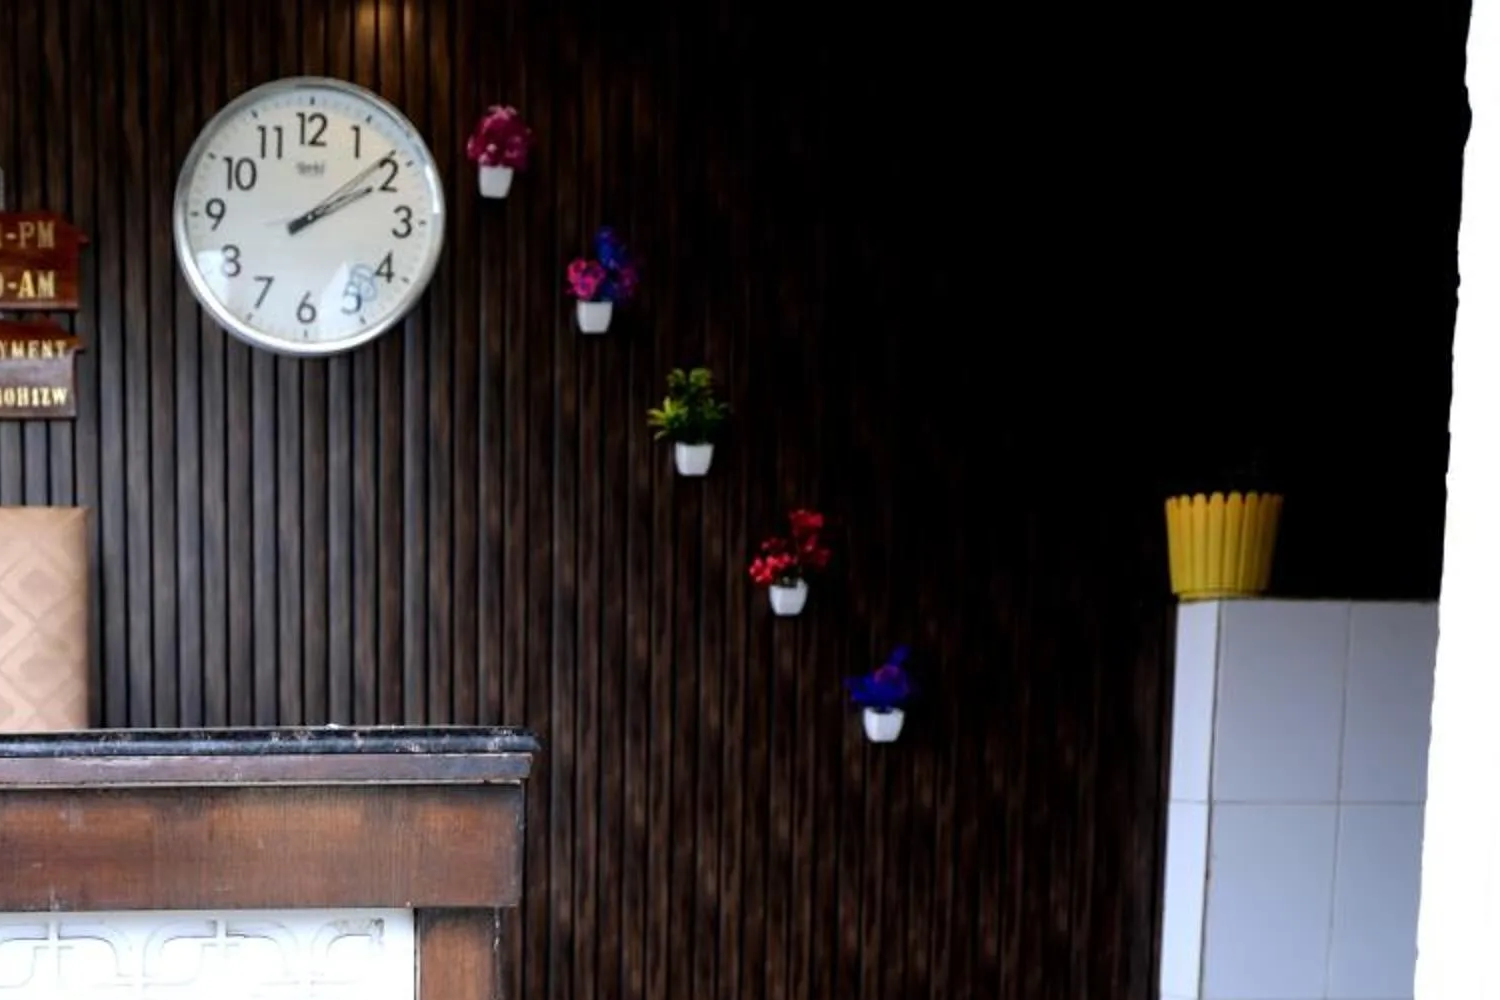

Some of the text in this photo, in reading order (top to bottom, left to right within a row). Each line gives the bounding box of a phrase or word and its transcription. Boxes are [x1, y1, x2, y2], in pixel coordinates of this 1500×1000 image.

[257, 125, 283, 160] 11
[296, 112, 328, 146] 12
[350, 125, 361, 159] 1
[223, 156, 257, 191] 10
[378, 157, 399, 192] 2
[205, 198, 226, 231] 9
[392, 206, 413, 238] 3
[375, 252, 395, 284] 4
[254, 276, 275, 309] 7
[296, 292, 316, 323] 6
[341, 281, 362, 315] 5
